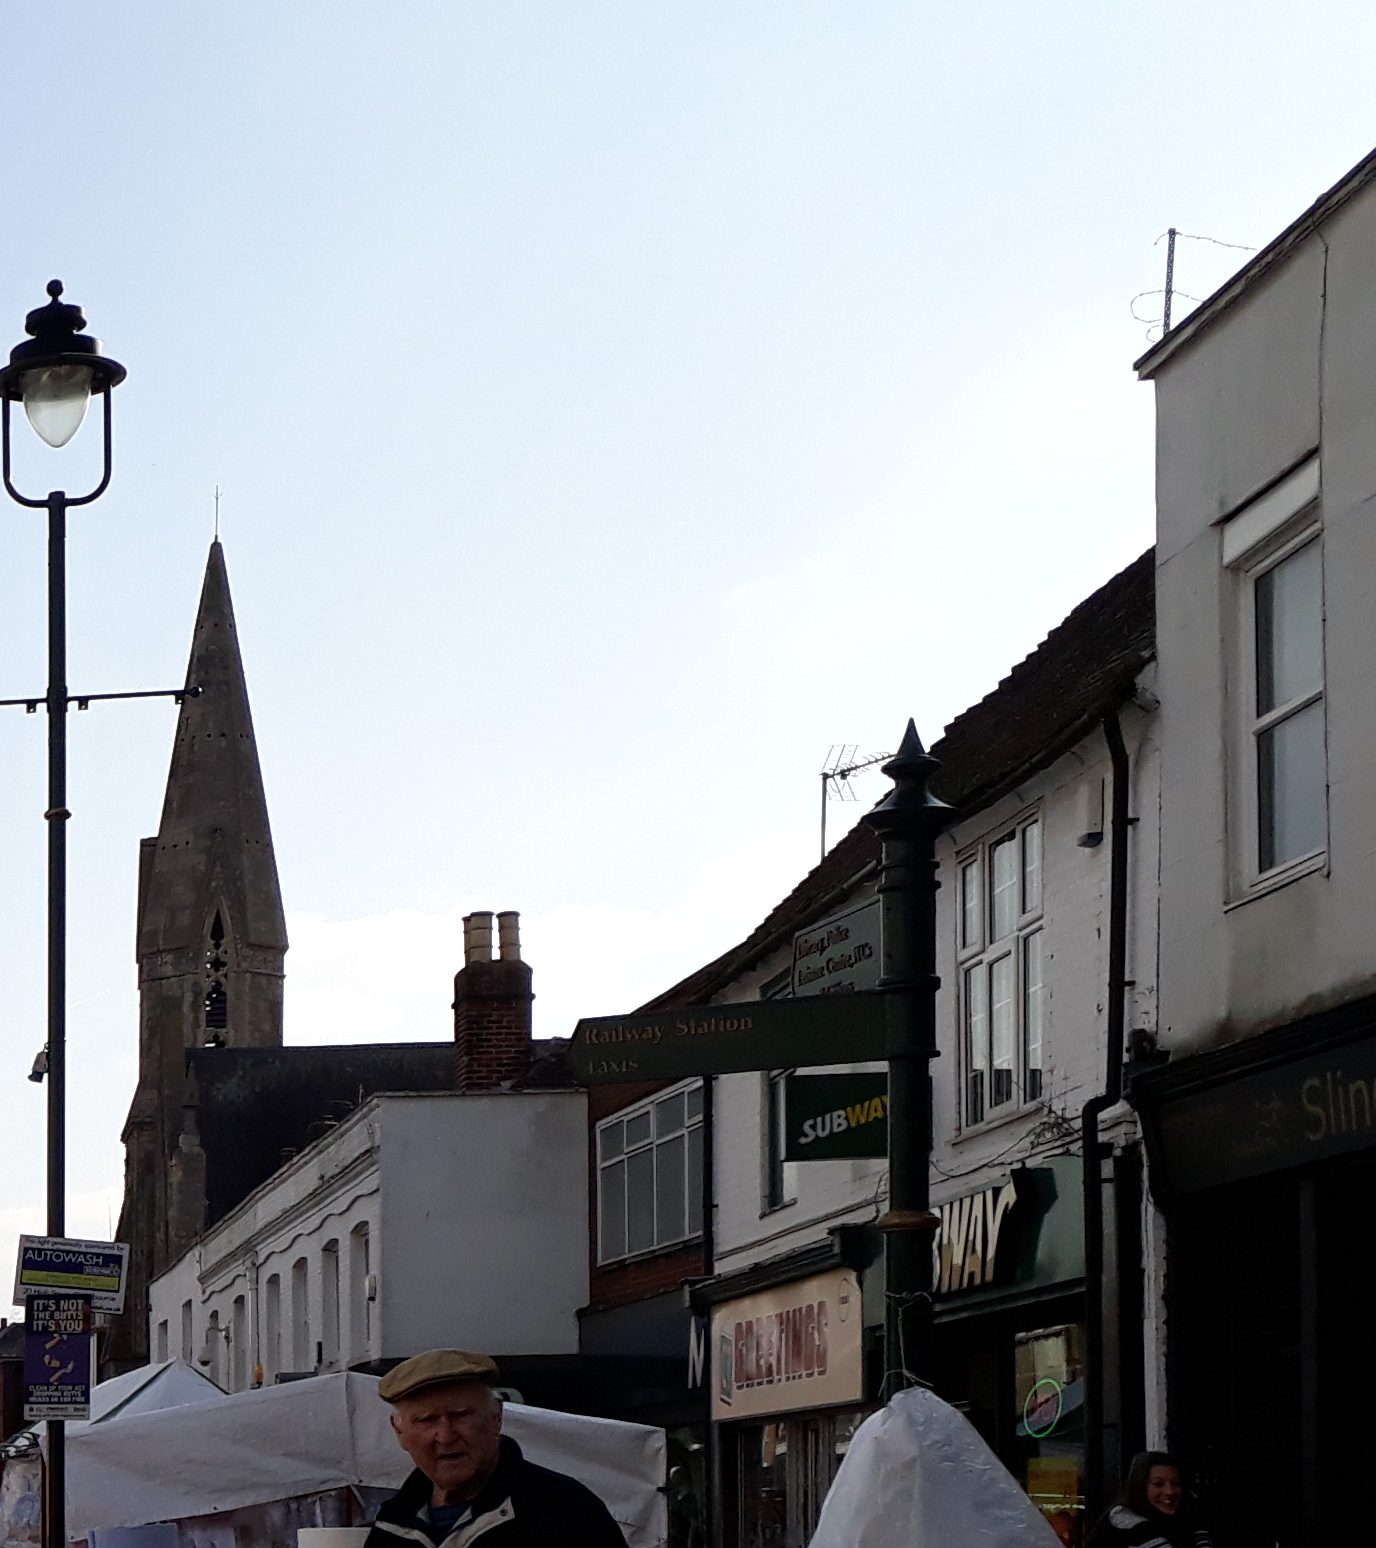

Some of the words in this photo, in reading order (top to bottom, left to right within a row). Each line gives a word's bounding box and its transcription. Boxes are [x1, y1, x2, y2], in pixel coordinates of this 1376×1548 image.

[585, 1023, 664, 1046] Railway
[675, 1016, 753, 1038] Station
[587, 1059, 639, 1075] Taxis
[1302, 1070, 1376, 1141] Slin
[25, 1249, 103, 1265] AUTOWASH
[33, 1299, 56, 1311] IT'S
[60, 1299, 84, 1311] NOT
[33, 1311, 52, 1320] THE
[54, 1311, 84, 1320] BUTTS
[32, 1320, 56, 1331] IT'S
[59, 1320, 84, 1331] YOU
